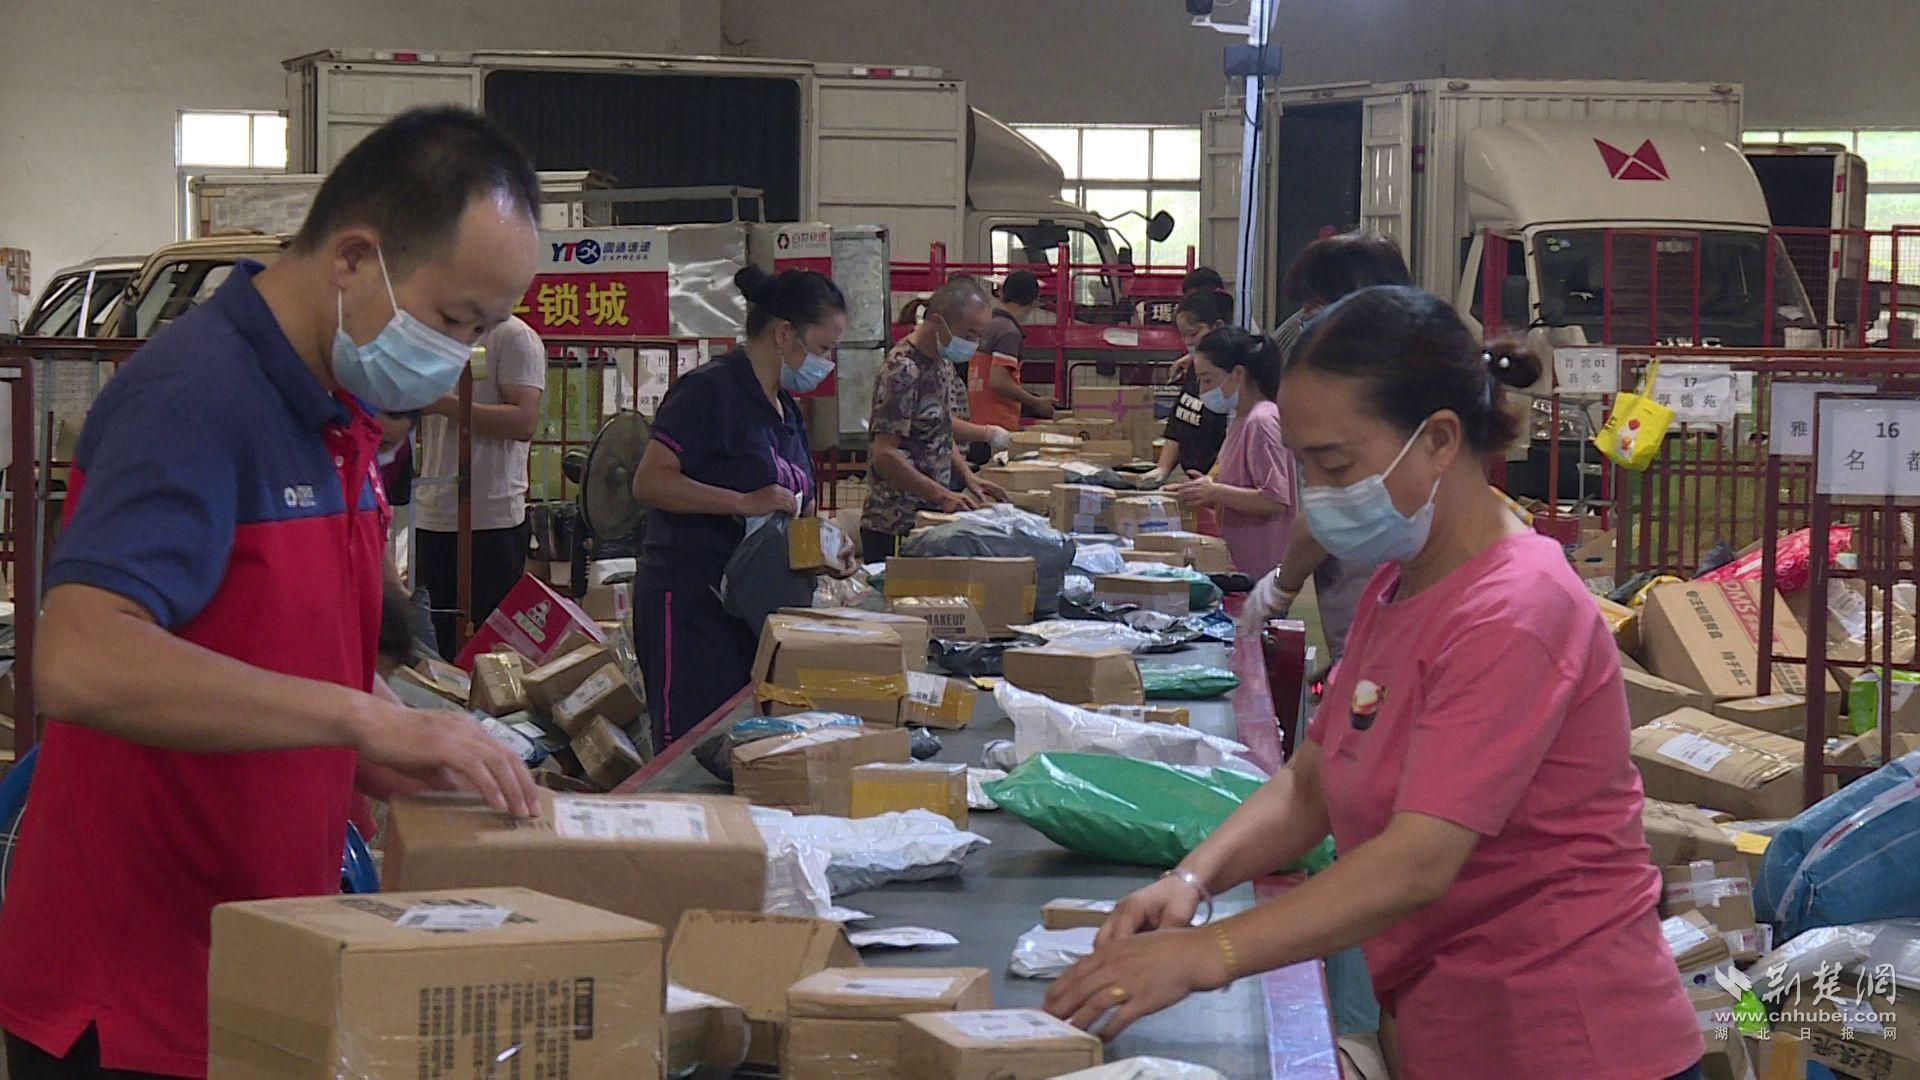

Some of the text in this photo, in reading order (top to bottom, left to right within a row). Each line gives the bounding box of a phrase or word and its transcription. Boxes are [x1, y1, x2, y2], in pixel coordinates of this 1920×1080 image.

[511, 282, 630, 326] 锁城
[1684, 377, 1698, 388] 17
[1876, 421, 1900, 438] 16
